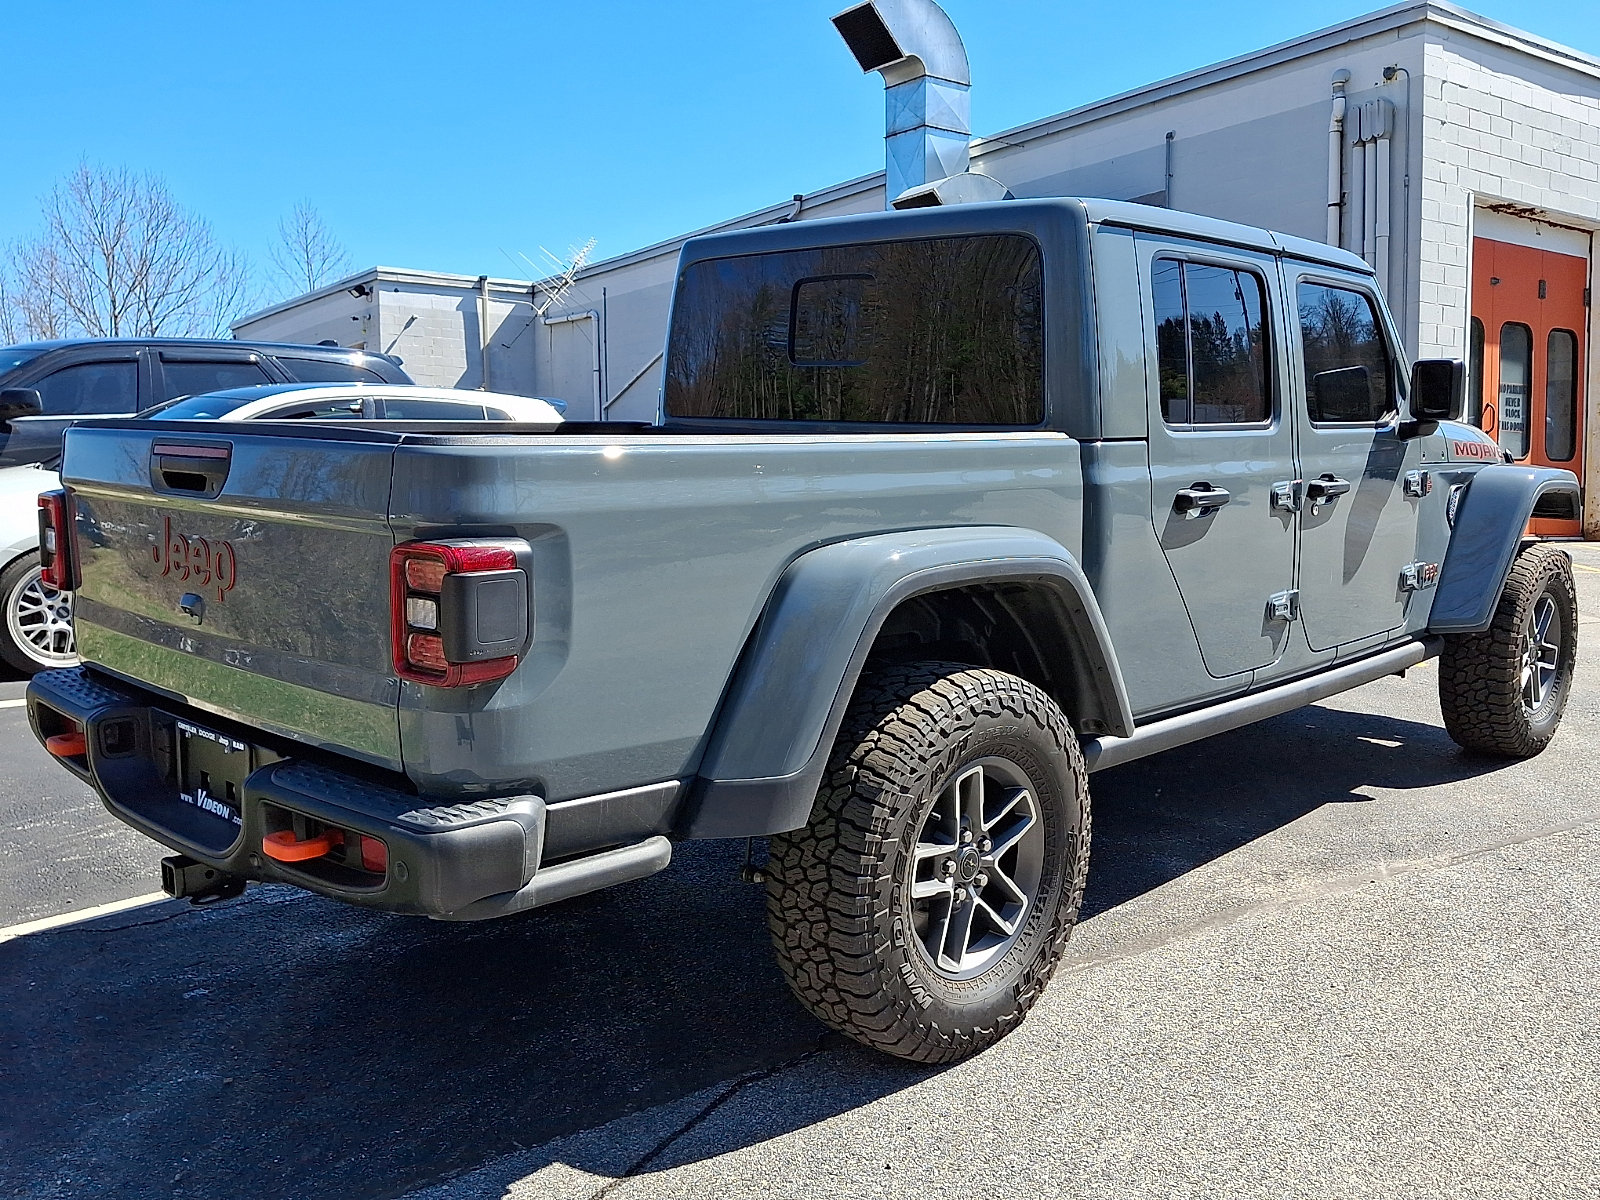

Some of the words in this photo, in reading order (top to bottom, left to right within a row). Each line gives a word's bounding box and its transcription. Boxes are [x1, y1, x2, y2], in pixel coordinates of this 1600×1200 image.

[1505, 398, 1520, 407] NEVER
[1505, 409, 1520, 418] BLOCK
[153, 516, 236, 602] Jeep
